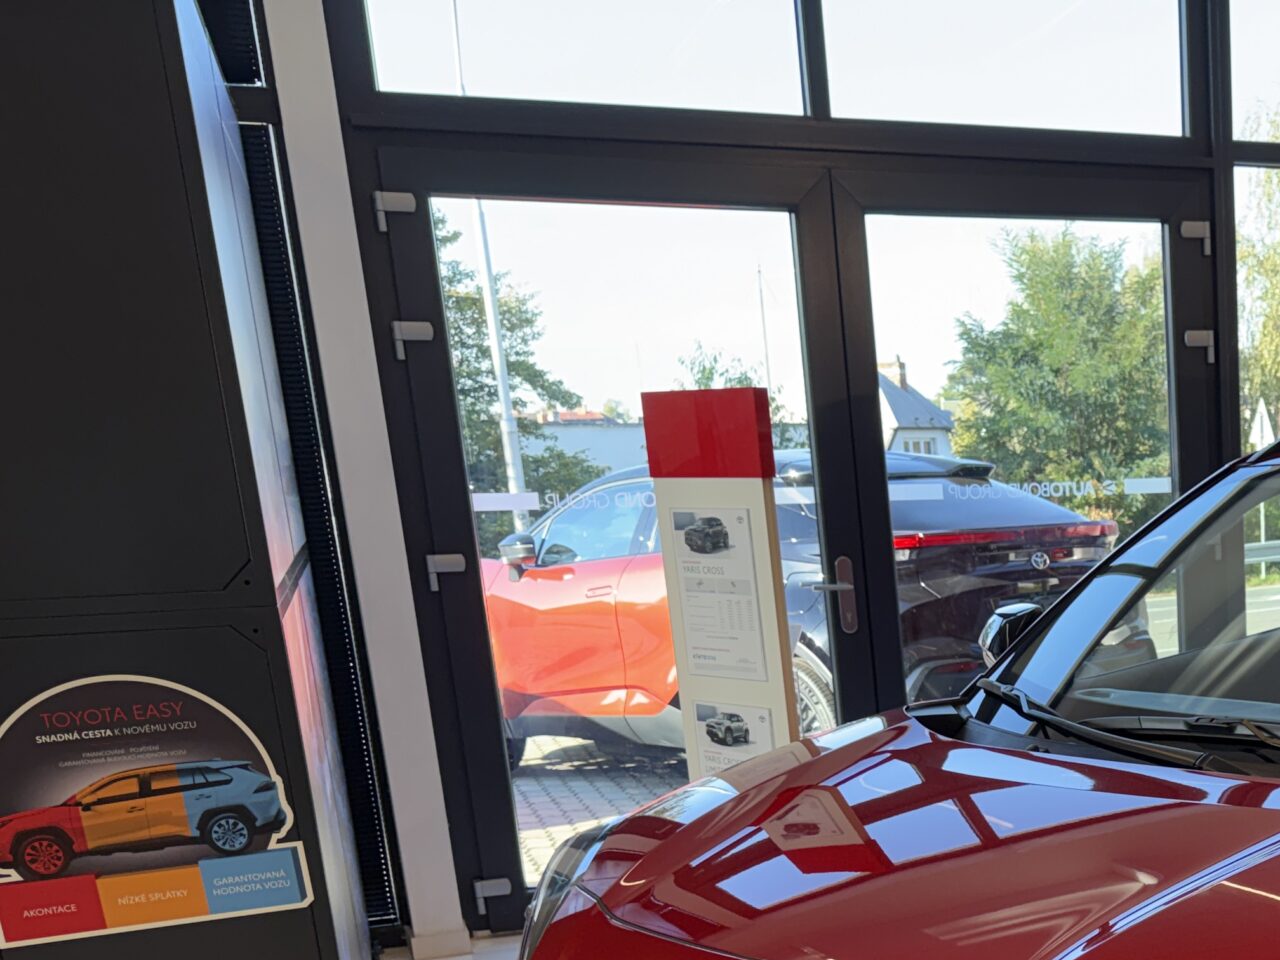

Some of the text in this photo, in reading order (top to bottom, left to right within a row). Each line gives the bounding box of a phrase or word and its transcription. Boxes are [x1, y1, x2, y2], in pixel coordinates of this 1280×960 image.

[40, 701, 184, 729] TOYOTA EASY
[35, 720, 197, 744] SNADNÁ CESTA K NOVÉMU VOZU
[213, 869, 287, 887] GARANTOVANÁ
[212, 879, 291, 896] HODNOTA VOZU
[117, 889, 189, 906] NÍZKÉ SPLÁTKY
[22, 903, 78, 918] AKONTACE
